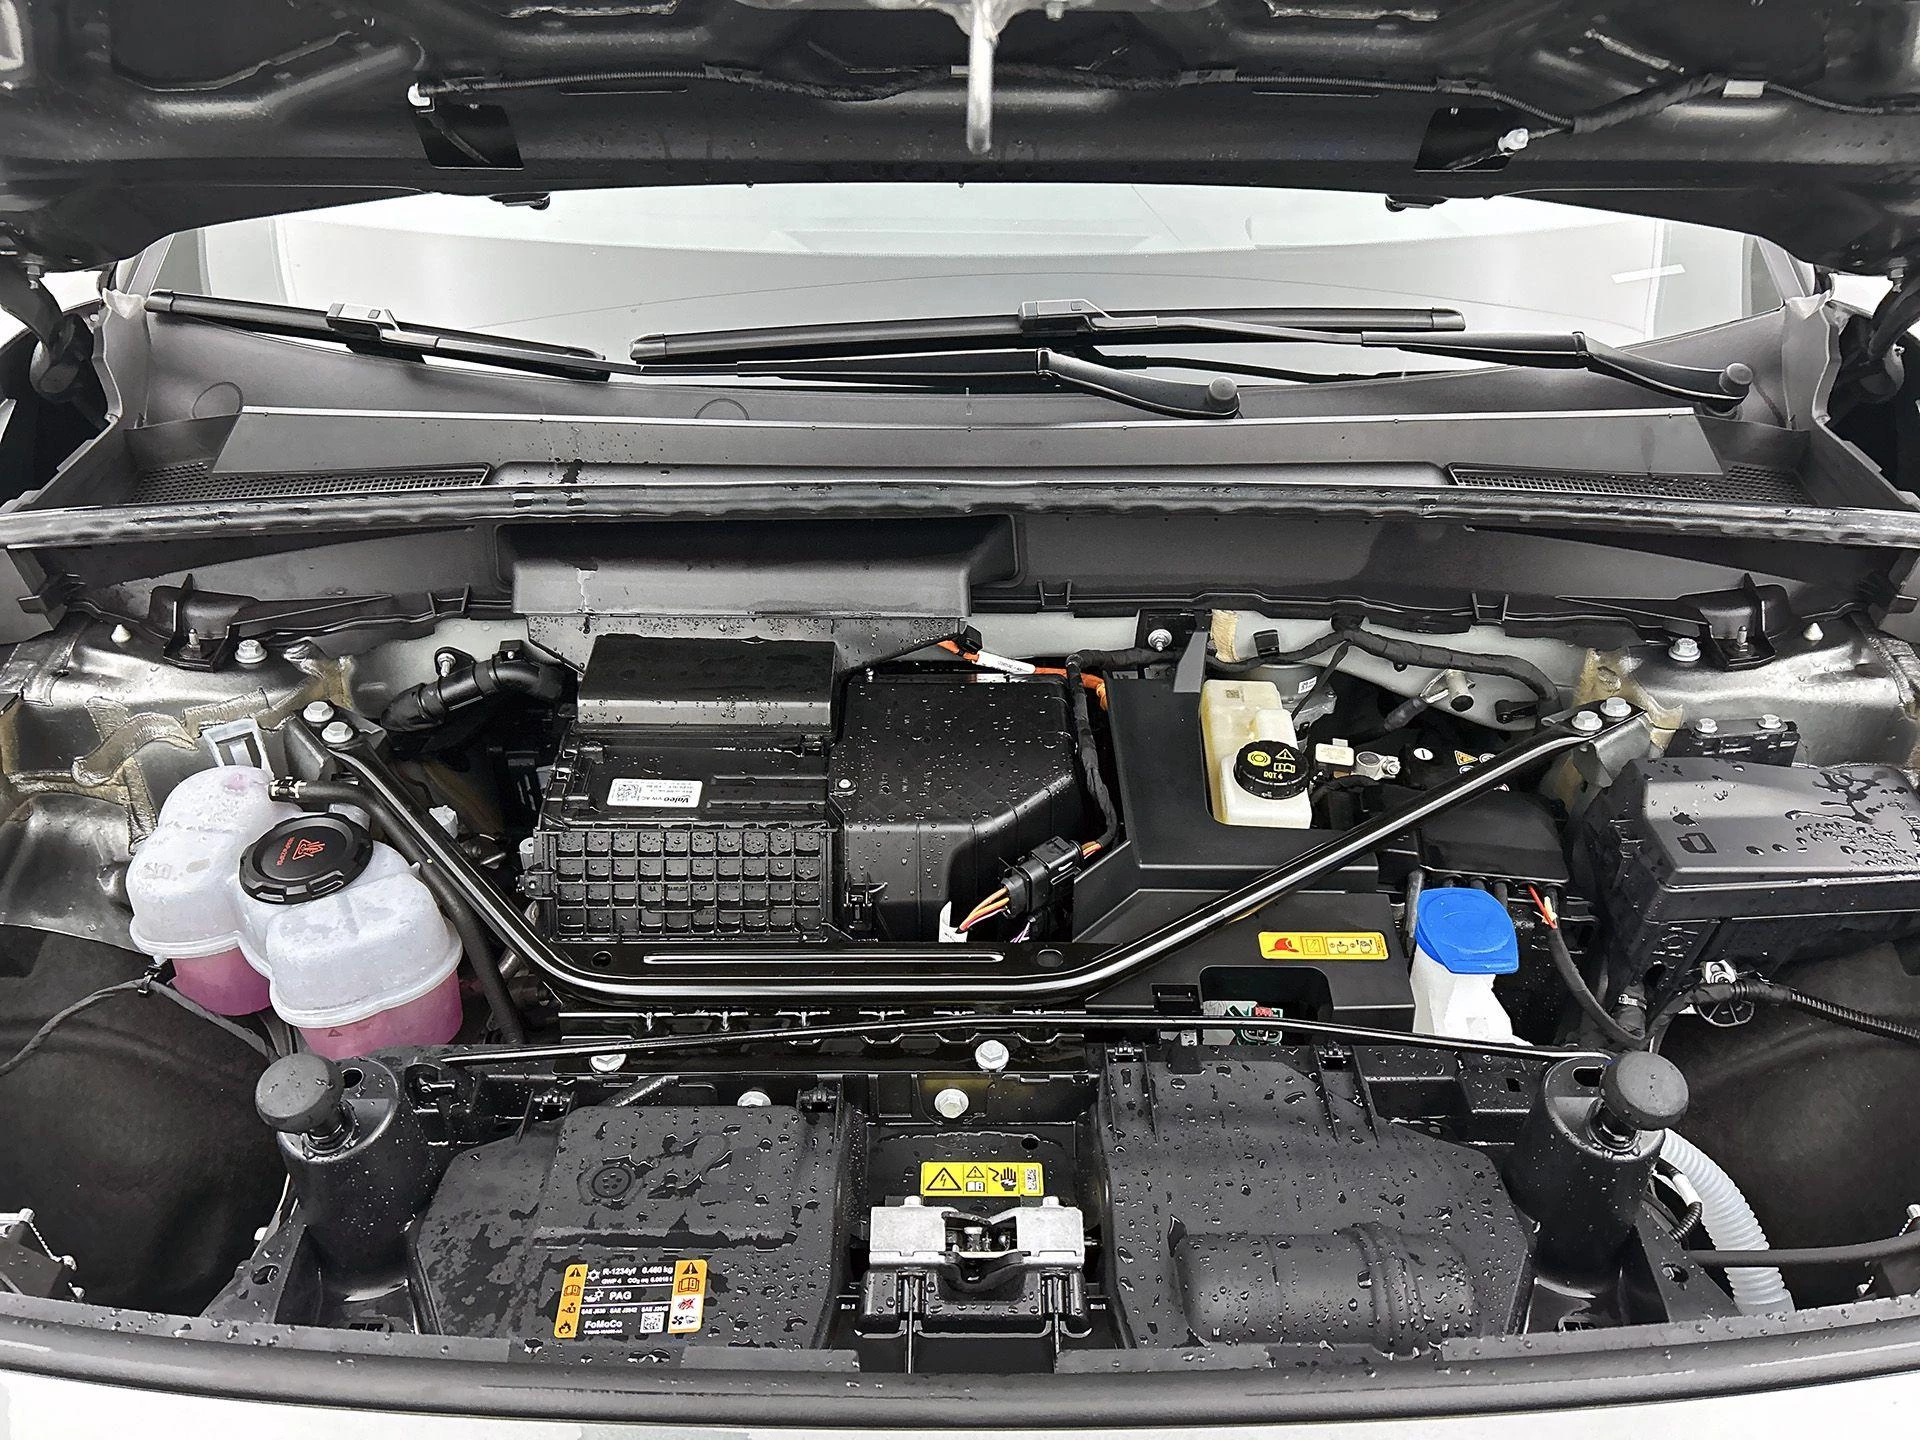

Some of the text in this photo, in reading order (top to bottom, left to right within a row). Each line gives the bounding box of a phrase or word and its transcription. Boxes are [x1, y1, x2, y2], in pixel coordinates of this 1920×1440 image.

[602, 1267, 637, 1276] R-1234yf
[663, 1265, 674, 1275] kg
[609, 1290, 632, 1301] PAG
[585, 1319, 623, 1329] FoMoCo
